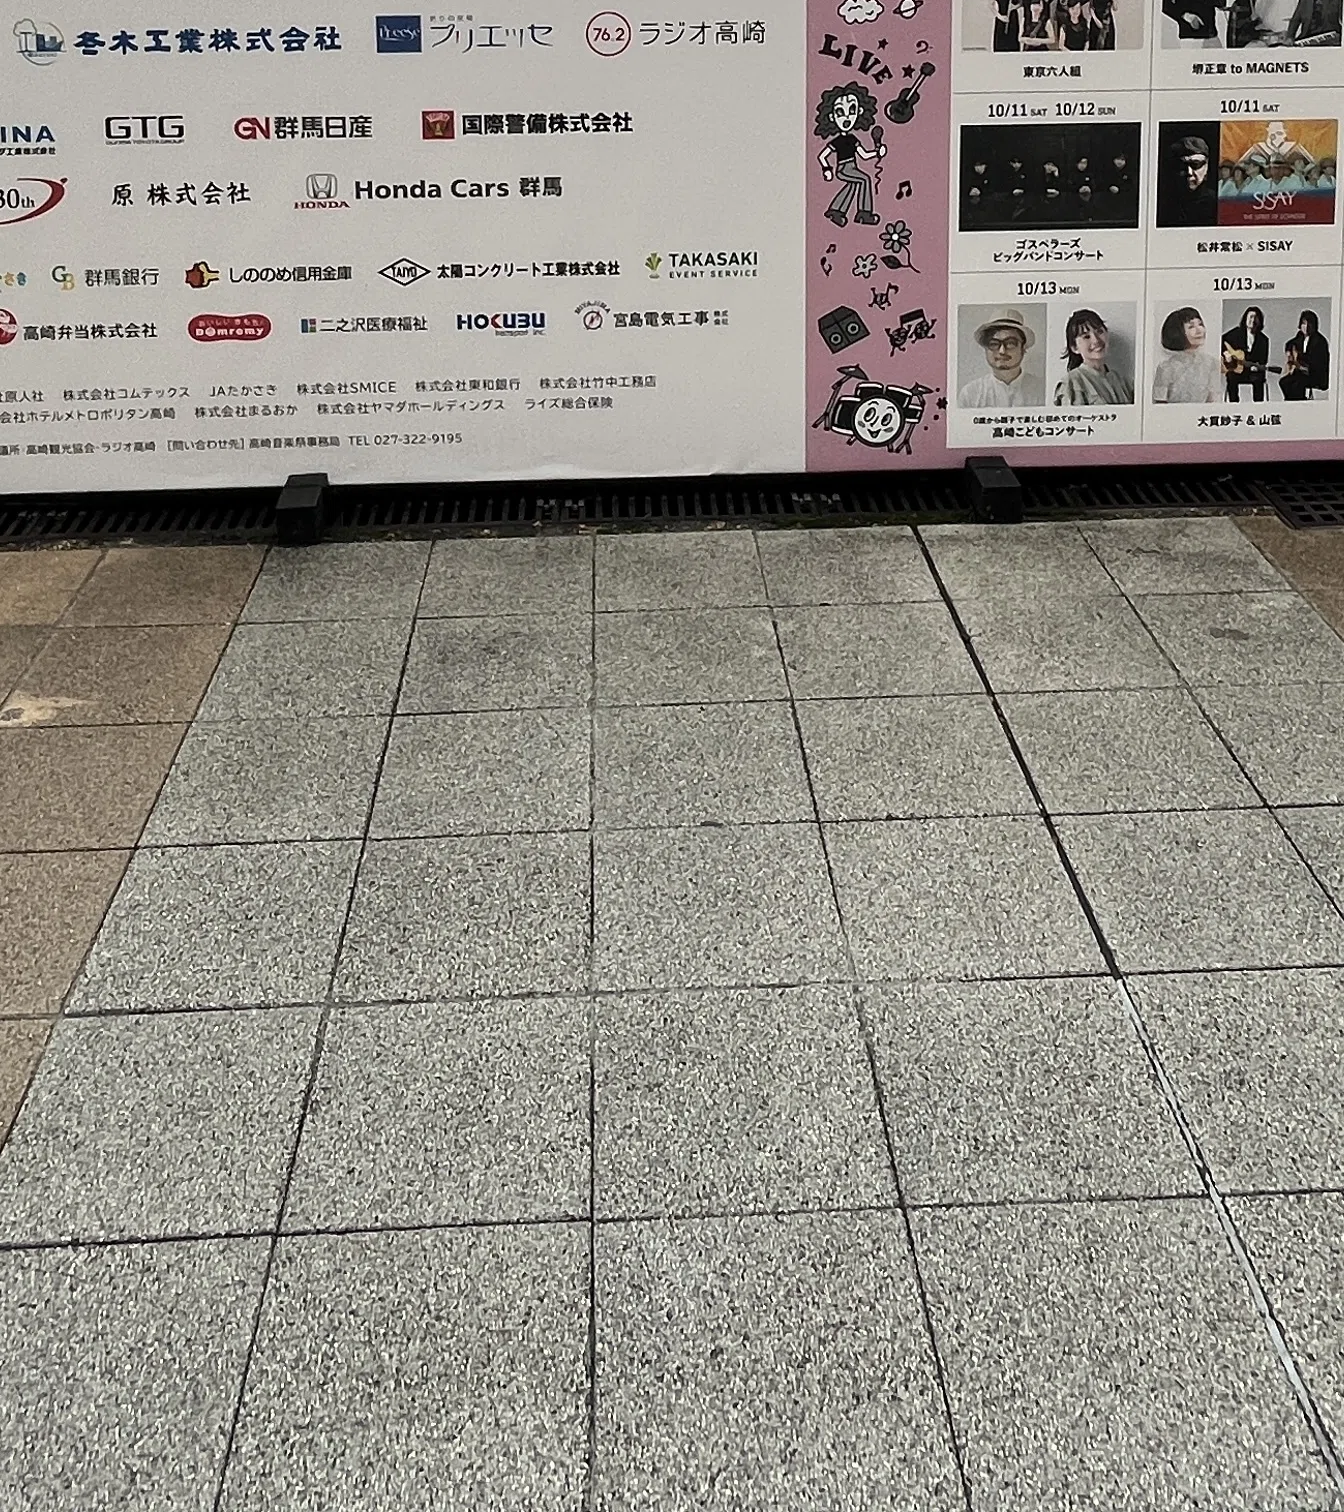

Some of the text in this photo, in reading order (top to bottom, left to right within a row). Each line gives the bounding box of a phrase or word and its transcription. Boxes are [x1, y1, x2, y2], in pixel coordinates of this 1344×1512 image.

[73, 26, 342, 55] 冬木工業株式会社
[430, 25, 553, 53] プリエッセ
[593, 28, 625, 42] 76.2
[639, 20, 765, 45] ラジオ高崎
[818, 34, 893, 85] LIVE
[1246, 62, 1309, 73] MAGNETS
[988, 103, 1027, 117] 10/11
[1056, 102, 1095, 116] 10/12
[1221, 99, 1259, 113] 10/11
[105, 116, 185, 139] GTG
[234, 115, 373, 140] GN 群馬日産
[462, 112, 633, 135] 国際警備株式会社
[112, 181, 251, 206] 原 株式会社
[355, 177, 562, 200] Honda Cars 群馬
[294, 201, 350, 209] HONDA
[1016, 238, 1080, 250] ゴスペラーズ
[1258, 241, 1293, 251] SISAY
[668, 252, 757, 267] TAKASAKI
[993, 251, 1103, 263] ビッグバンドコンサート
[85, 268, 159, 287] 群馬銀行
[230, 266, 352, 283] しののめ信用金庫
[437, 260, 620, 278] 太陽コンクリート工業株式会社
[1018, 281, 1056, 295] 10/13
[1214, 278, 1252, 291] 10/13
[613, 310, 709, 328] 宮島電気工事
[23, 323, 158, 340] 高崎弁当株式会社
[209, 385, 277, 397] JAたかさき
[297, 381, 396, 396] 株式会社SMICE
[347, 433, 462, 449] TEL 027-322-9195
